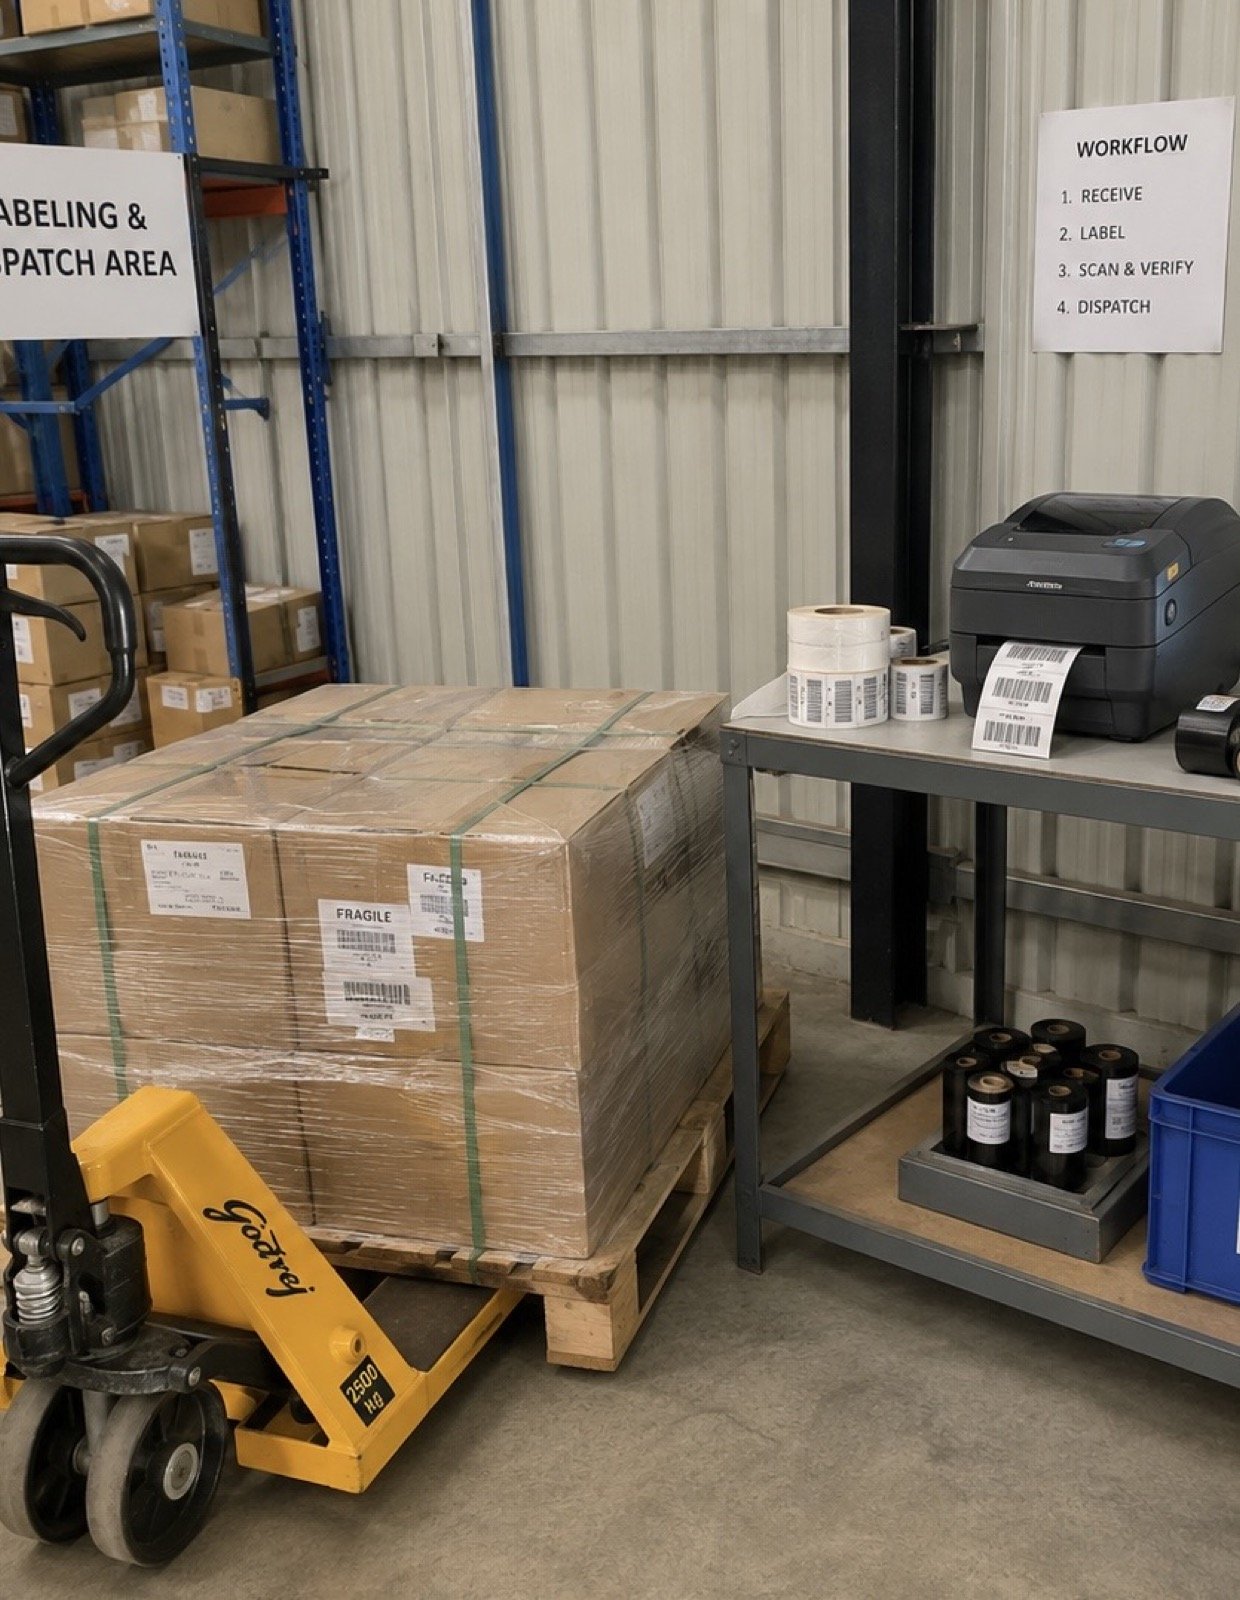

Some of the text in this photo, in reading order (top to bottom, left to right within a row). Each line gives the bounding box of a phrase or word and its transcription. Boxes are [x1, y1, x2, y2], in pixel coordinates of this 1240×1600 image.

[1077, 134, 1188, 158] WORKFLOW
[1062, 187, 1143, 204] 1. RECEIVE
[128, 203, 147, 230] &
[1059, 226, 1125, 241] 2. LABEL
[0, 247, 177, 276] PATCH AREA
[1058, 260, 1194, 278] 3. SCAN & VERIFY
[1057, 300, 1151, 315] 4. DISPATCH
[336, 908, 392, 923] FRAGILE
[203, 1199, 315, 1297] Godrej
[346, 1364, 378, 1404] 2500
